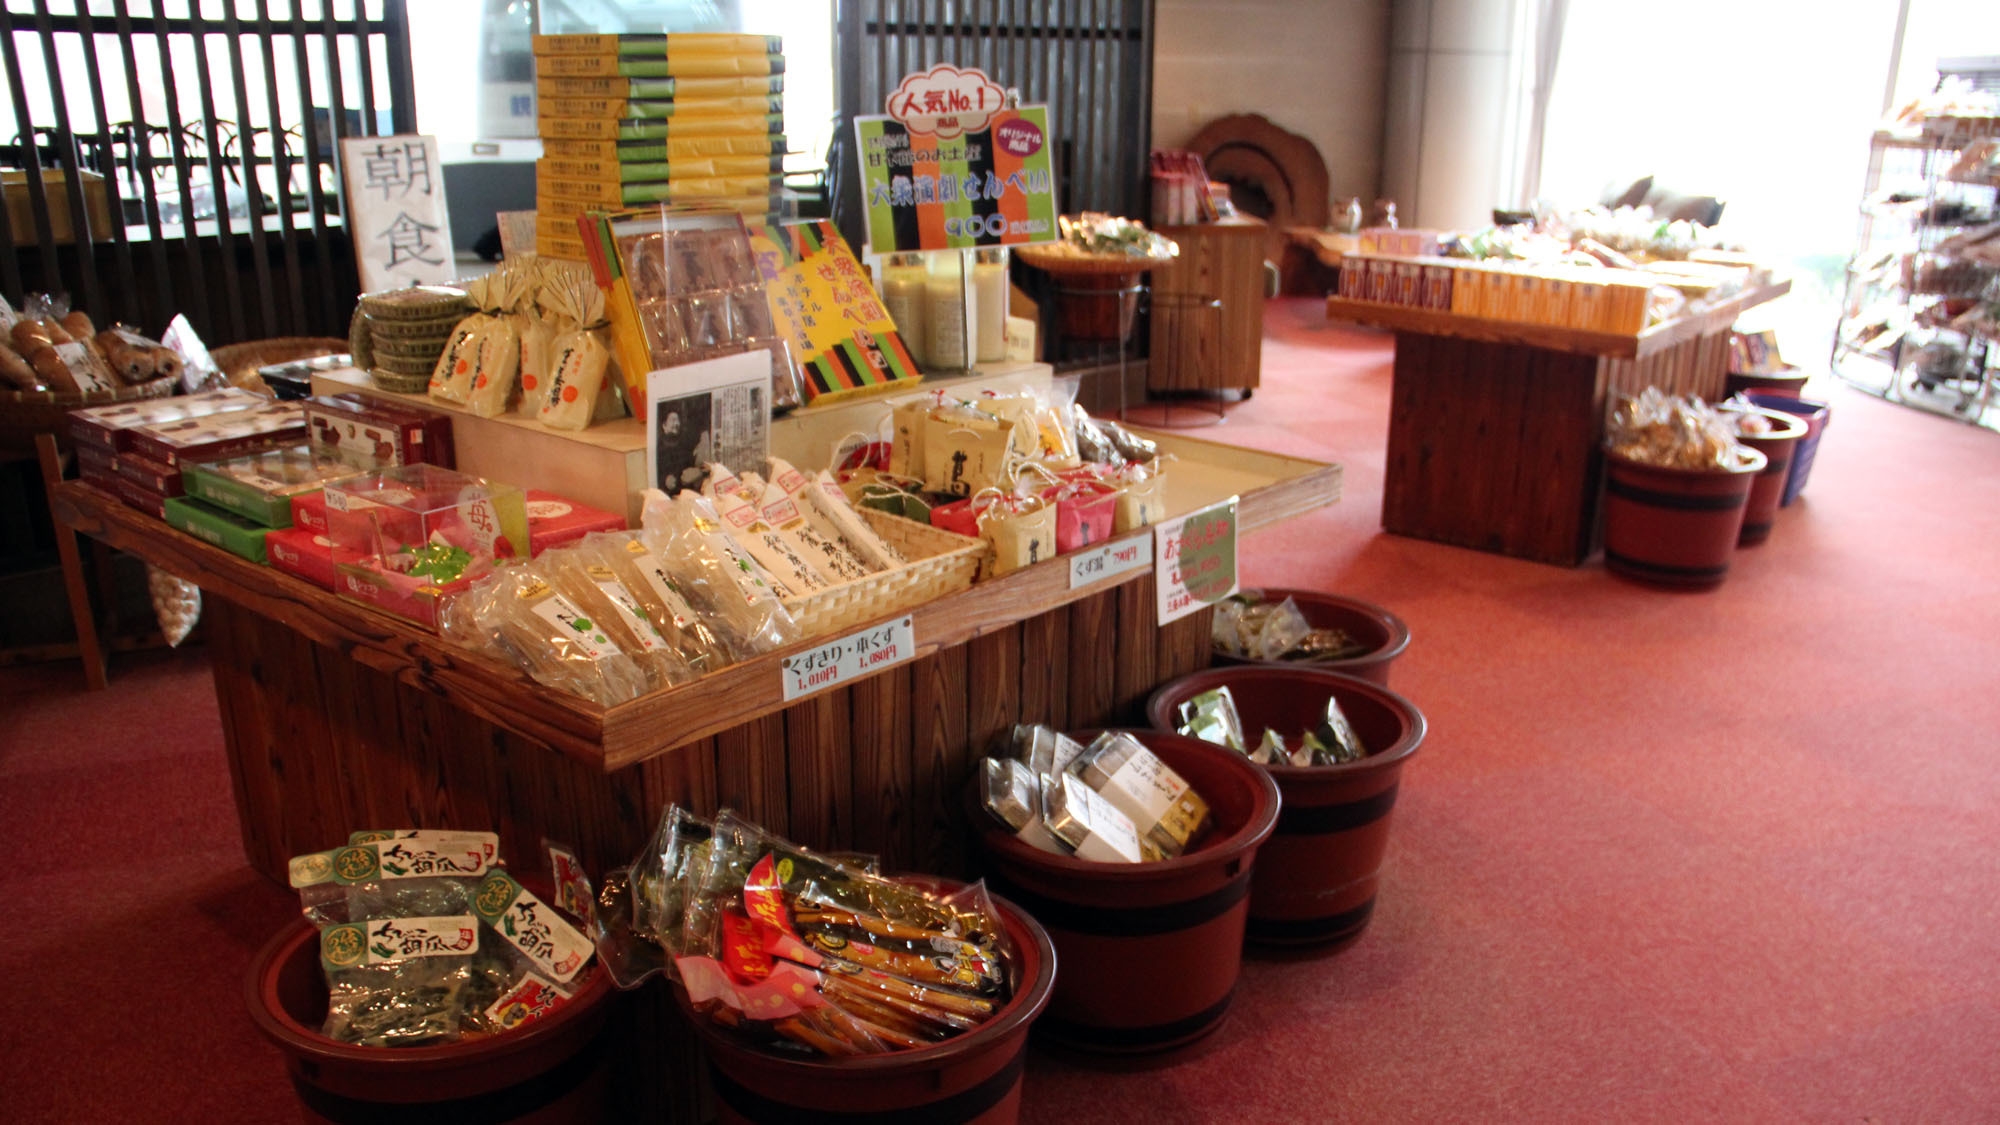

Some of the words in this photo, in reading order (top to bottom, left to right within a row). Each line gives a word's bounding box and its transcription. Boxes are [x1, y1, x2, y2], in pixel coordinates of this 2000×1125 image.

[901, 87, 984, 116] 人気No.1
[999, 126, 1042, 145] オリジナル
[361, 141, 445, 287] 朝食
[797, 664, 837, 691] 1,010円
[859, 643, 897, 669] 1,080円
